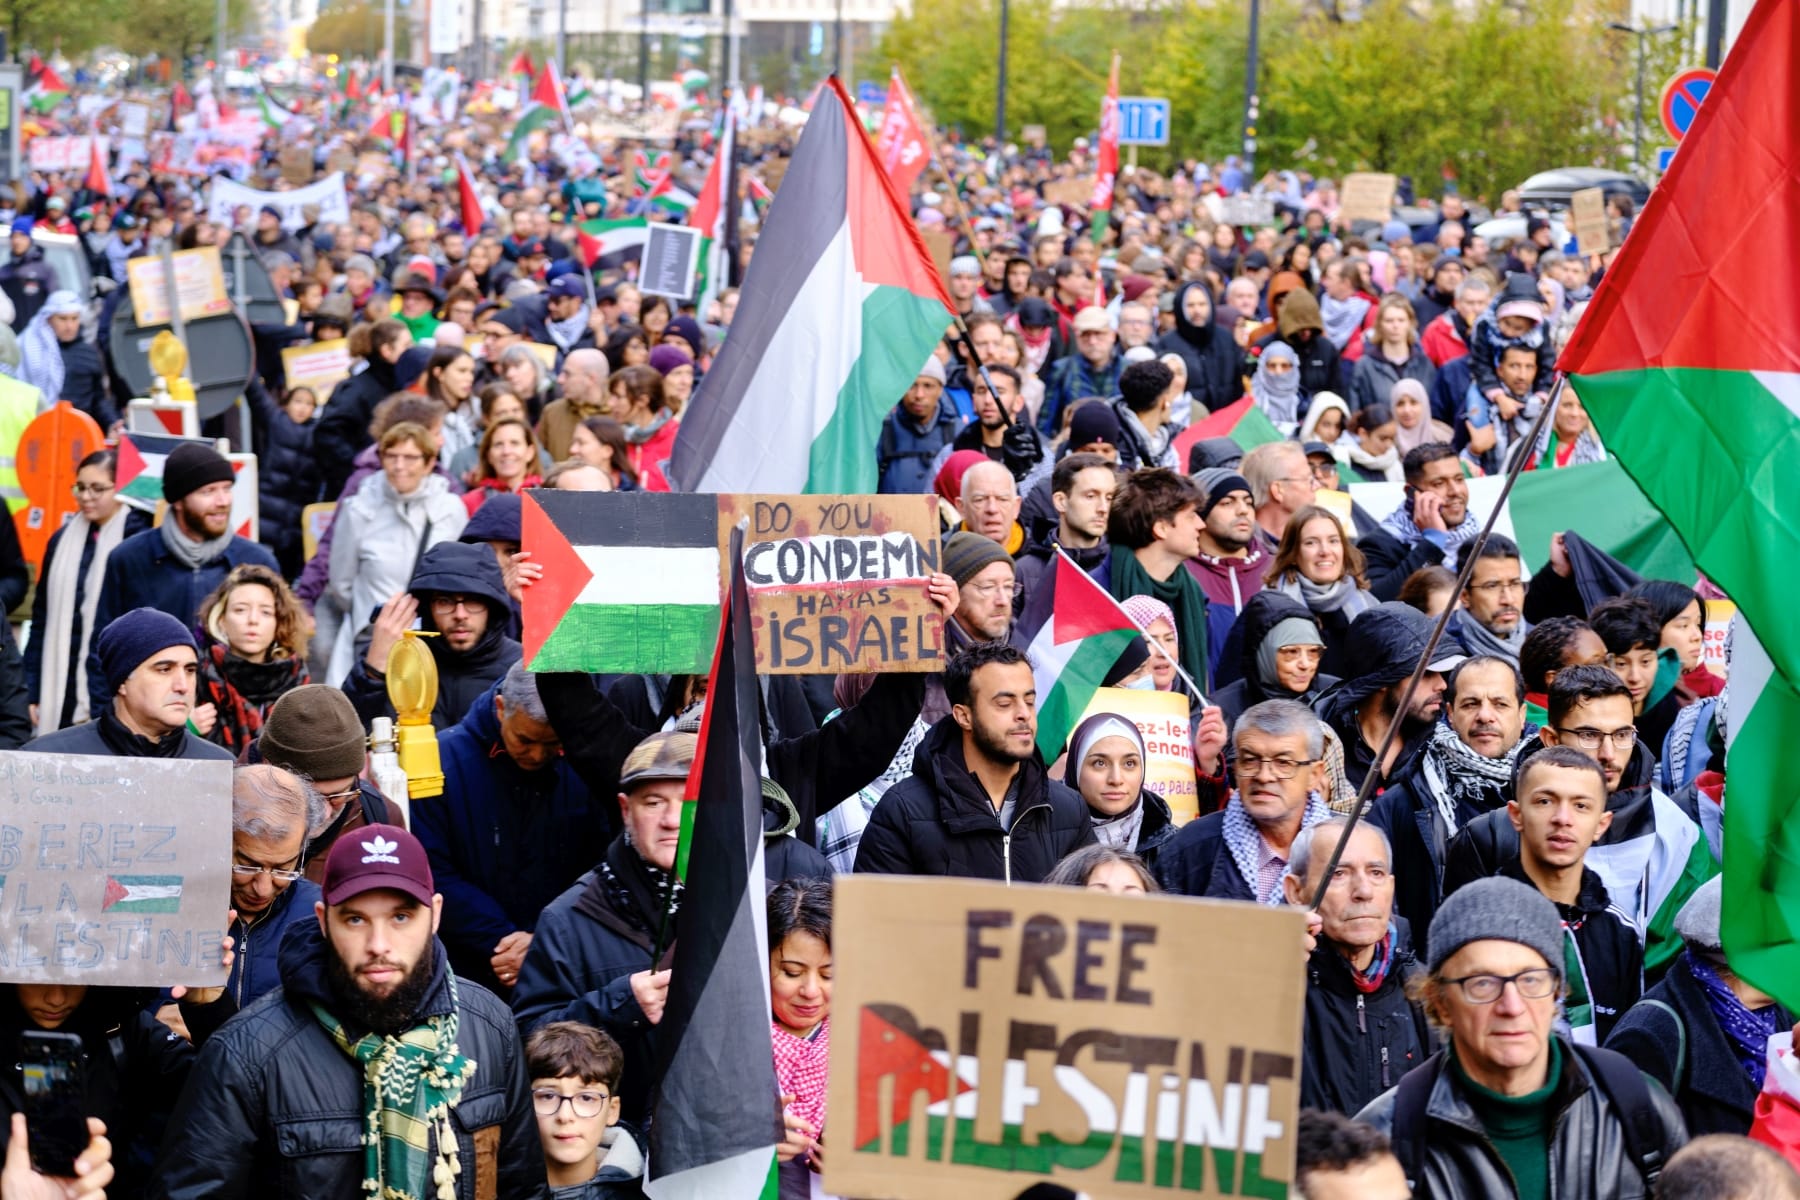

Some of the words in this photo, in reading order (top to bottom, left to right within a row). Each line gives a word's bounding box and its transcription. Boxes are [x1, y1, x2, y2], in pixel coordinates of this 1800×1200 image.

[755, 502, 792, 533] DO
[818, 502, 872, 531] YOU
[744, 537, 938, 584] CONDEMN
[963, 909, 1158, 1006] FREE
